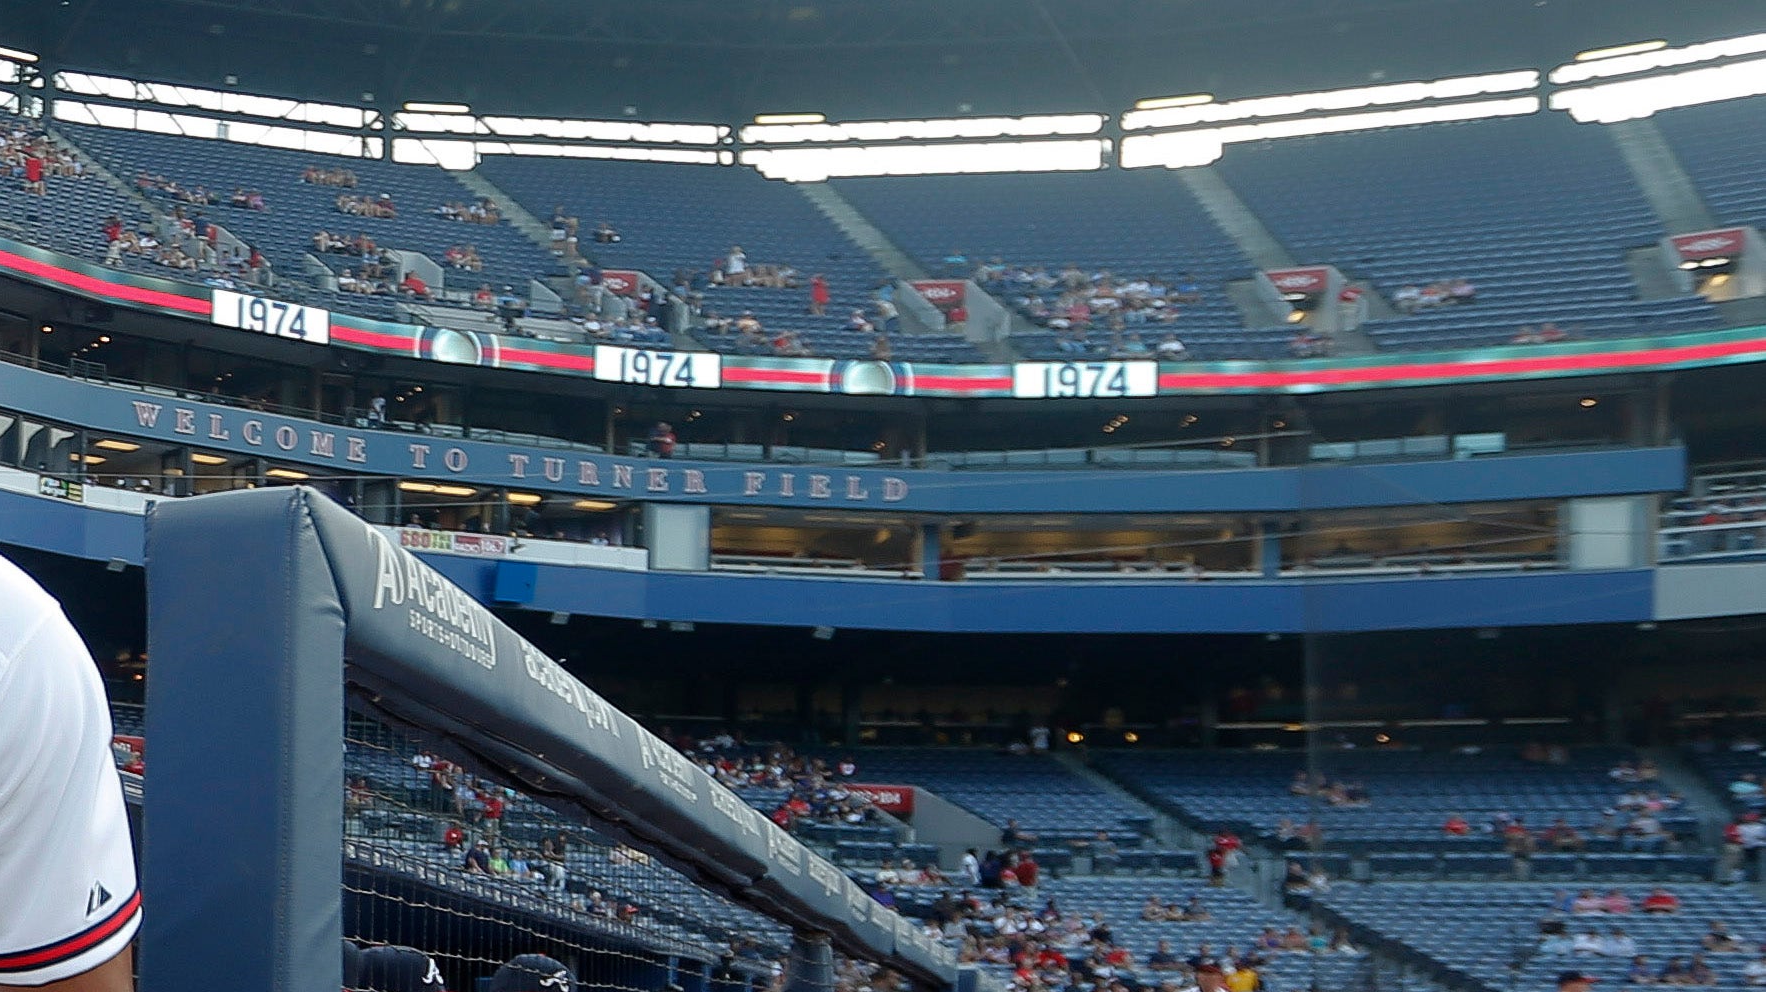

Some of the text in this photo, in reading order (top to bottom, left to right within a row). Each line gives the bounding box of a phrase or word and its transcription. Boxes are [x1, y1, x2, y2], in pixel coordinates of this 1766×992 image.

[237, 296, 307, 340] 1974
[620, 350, 695, 388] 1974
[1045, 363, 1129, 398] 1974
[132, 401, 910, 502] WELCOME TO TURNER FIELD
